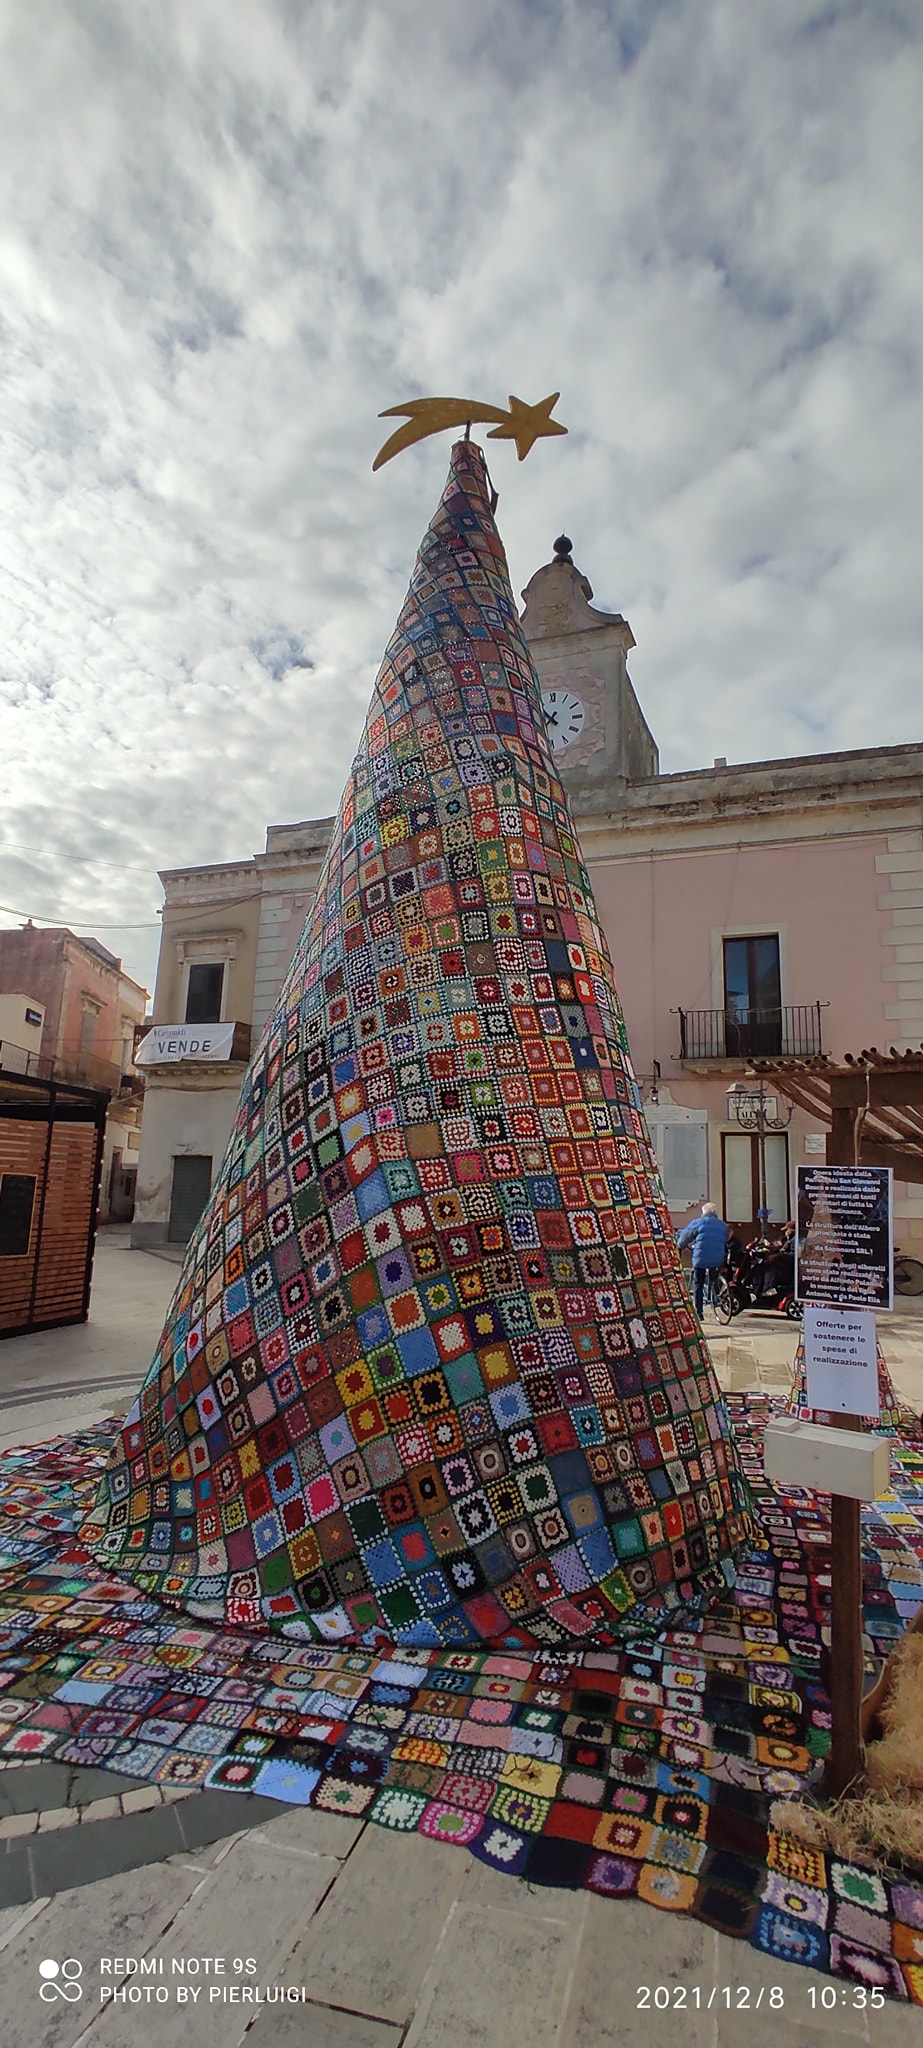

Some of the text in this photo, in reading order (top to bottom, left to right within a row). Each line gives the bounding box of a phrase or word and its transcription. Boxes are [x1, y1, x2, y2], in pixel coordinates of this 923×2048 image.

[158, 1040, 211, 1054] VENDE
[816, 1321, 845, 1329] Offerte
[813, 1333, 855, 1342] sostenere
[813, 1357, 868, 1367] realizzazione
